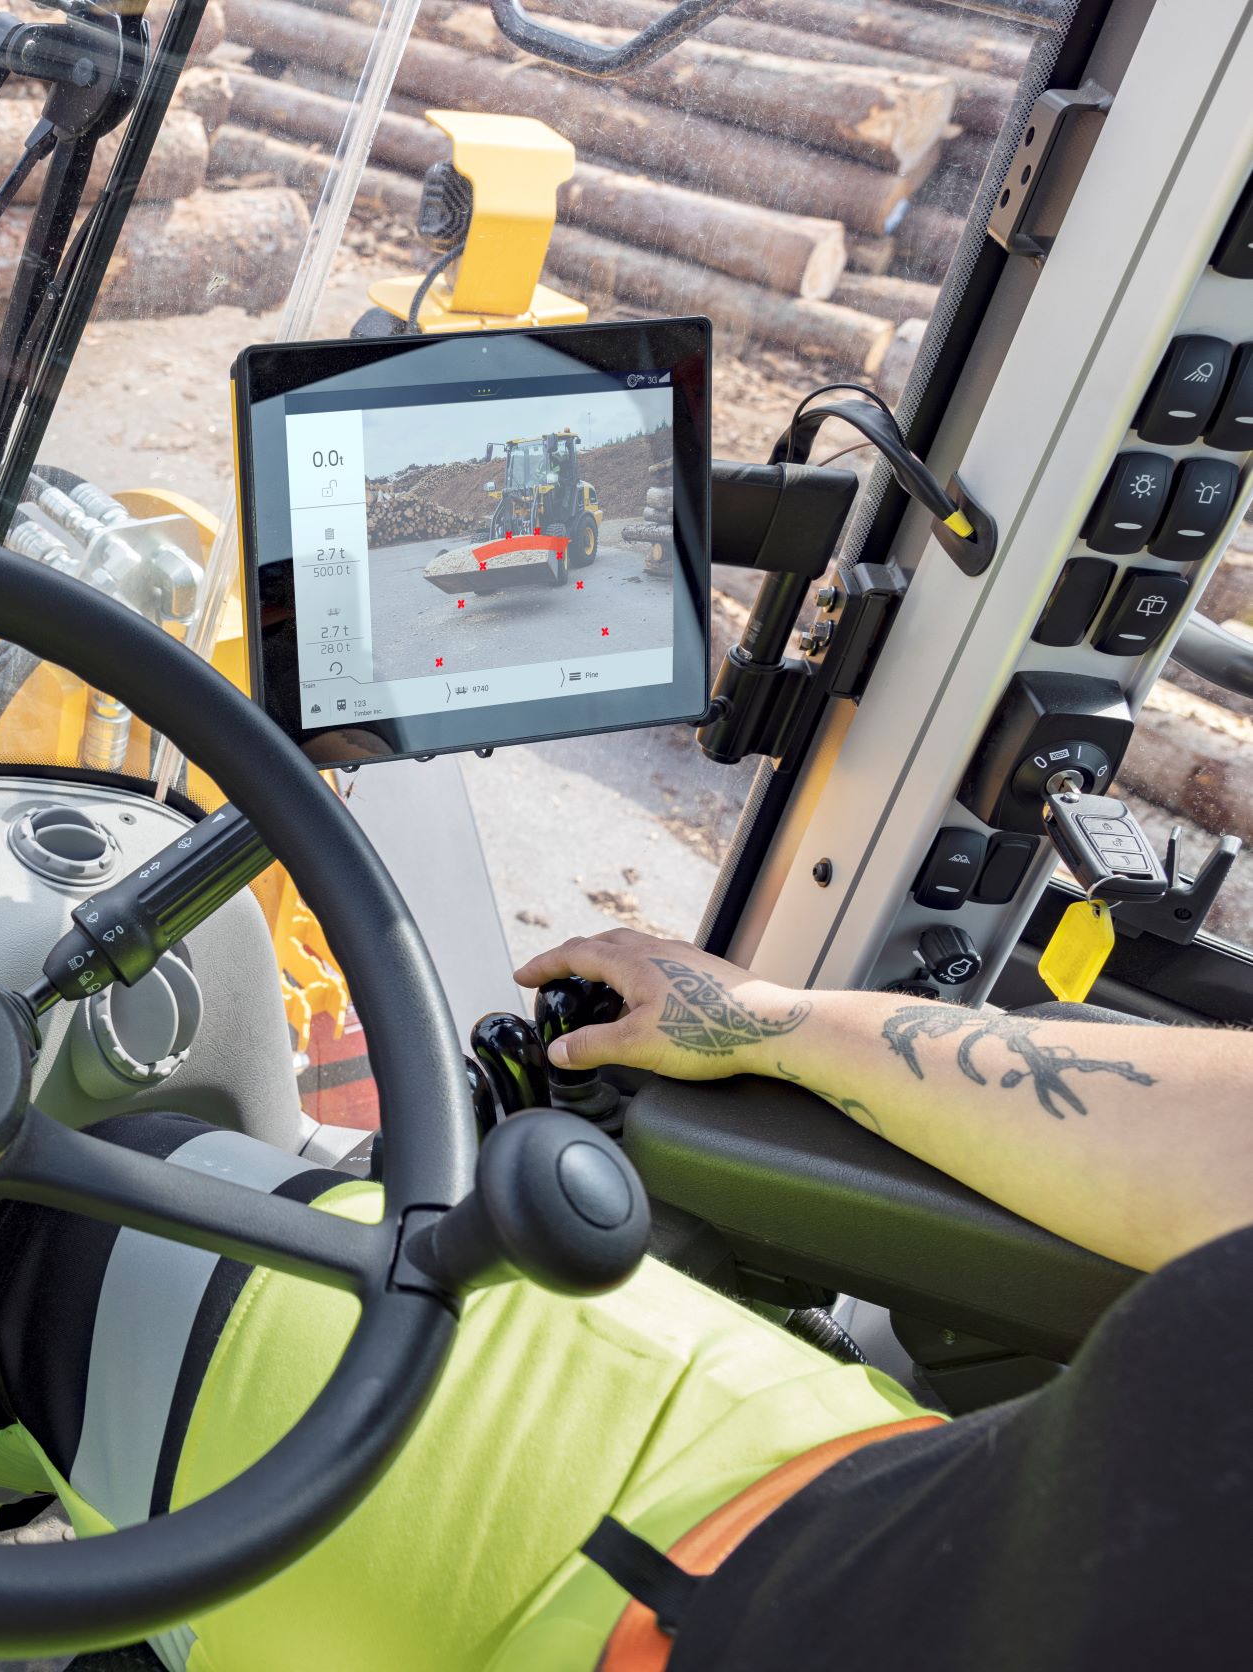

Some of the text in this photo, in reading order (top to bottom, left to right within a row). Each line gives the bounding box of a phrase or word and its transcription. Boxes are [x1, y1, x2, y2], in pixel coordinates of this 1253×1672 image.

[316, 548, 346, 561] 2.7 t
[346, 564, 351, 575] t
[321, 625, 350, 639] 2.7 t
[346, 641, 352, 652] t
[585, 671, 599, 679] Pine
[472, 684, 489, 693] 9740
[353, 699, 367, 708] 123
[354, 709, 372, 717] Timber
